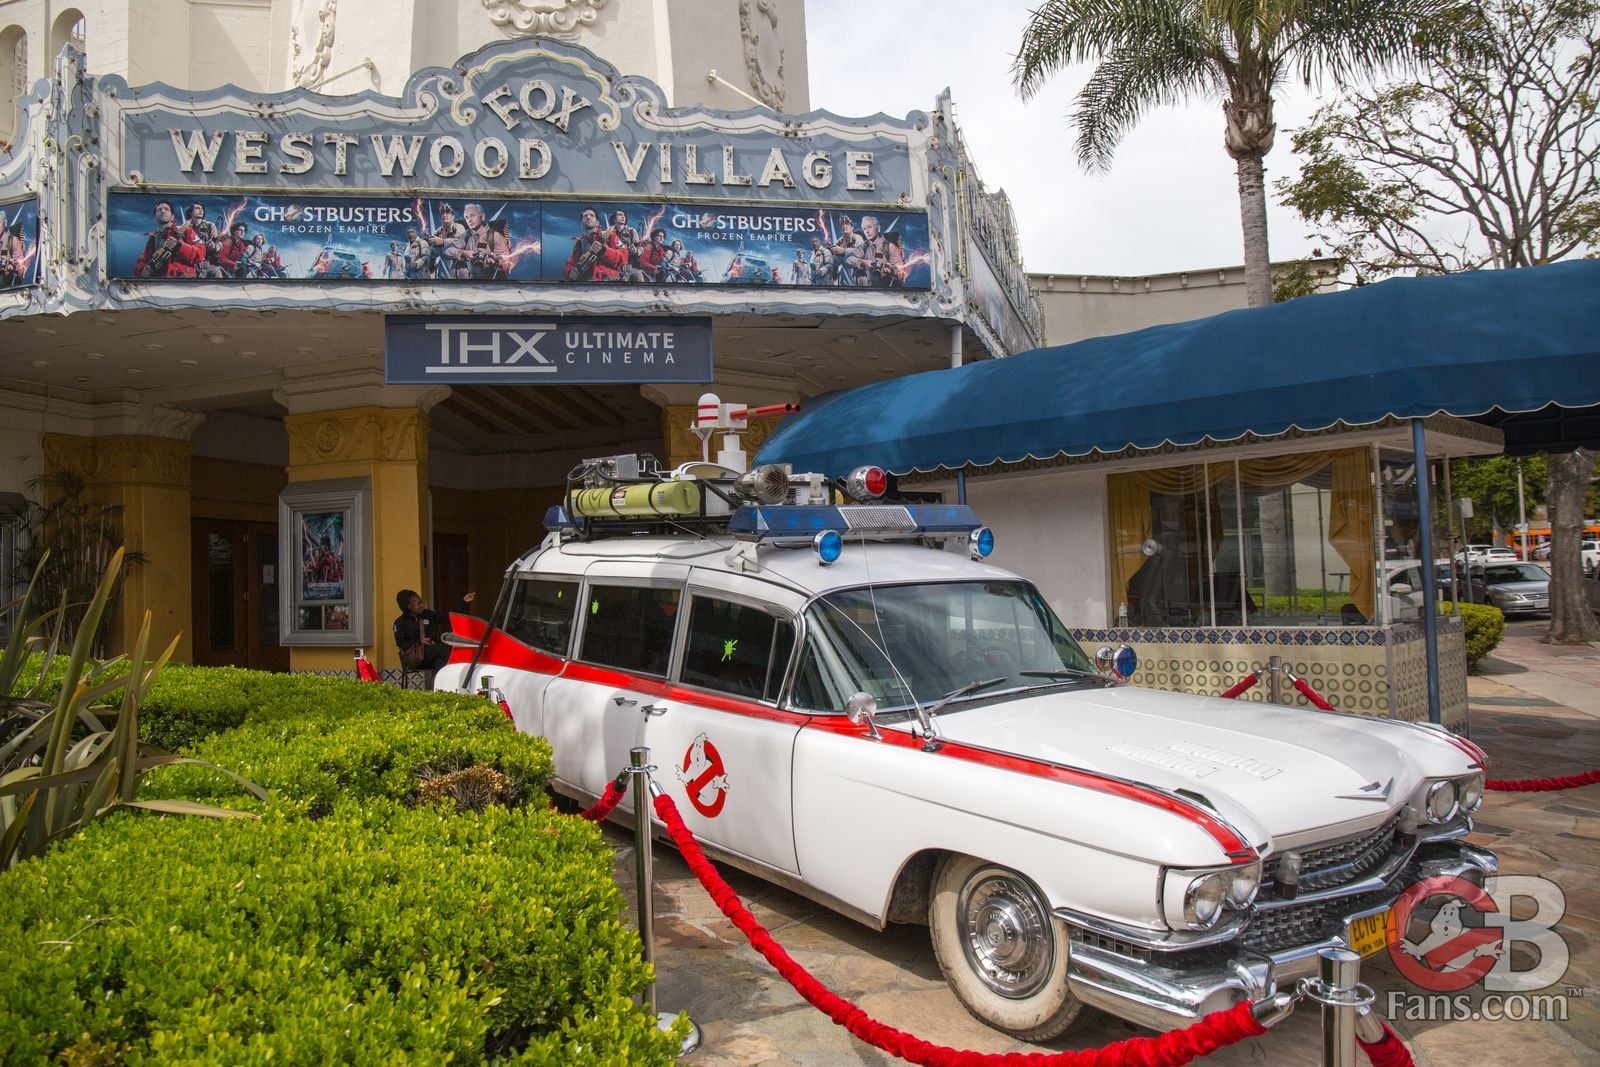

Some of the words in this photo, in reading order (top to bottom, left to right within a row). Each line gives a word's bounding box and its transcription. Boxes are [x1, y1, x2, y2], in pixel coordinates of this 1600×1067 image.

[481, 79, 592, 134] FOX
[167, 128, 552, 180] WESTWOOD
[611, 141, 876, 191] VILLAGE
[281, 225, 332, 233] FROZEN
[340, 225, 386, 234] EMPIRE
[697, 232, 743, 241] FROZEN
[750, 233, 793, 242] EMPIRE
[425, 323, 557, 365] THX
[565, 332, 675, 349] ULTIMATE
[565, 352, 675, 364] CINEMA
